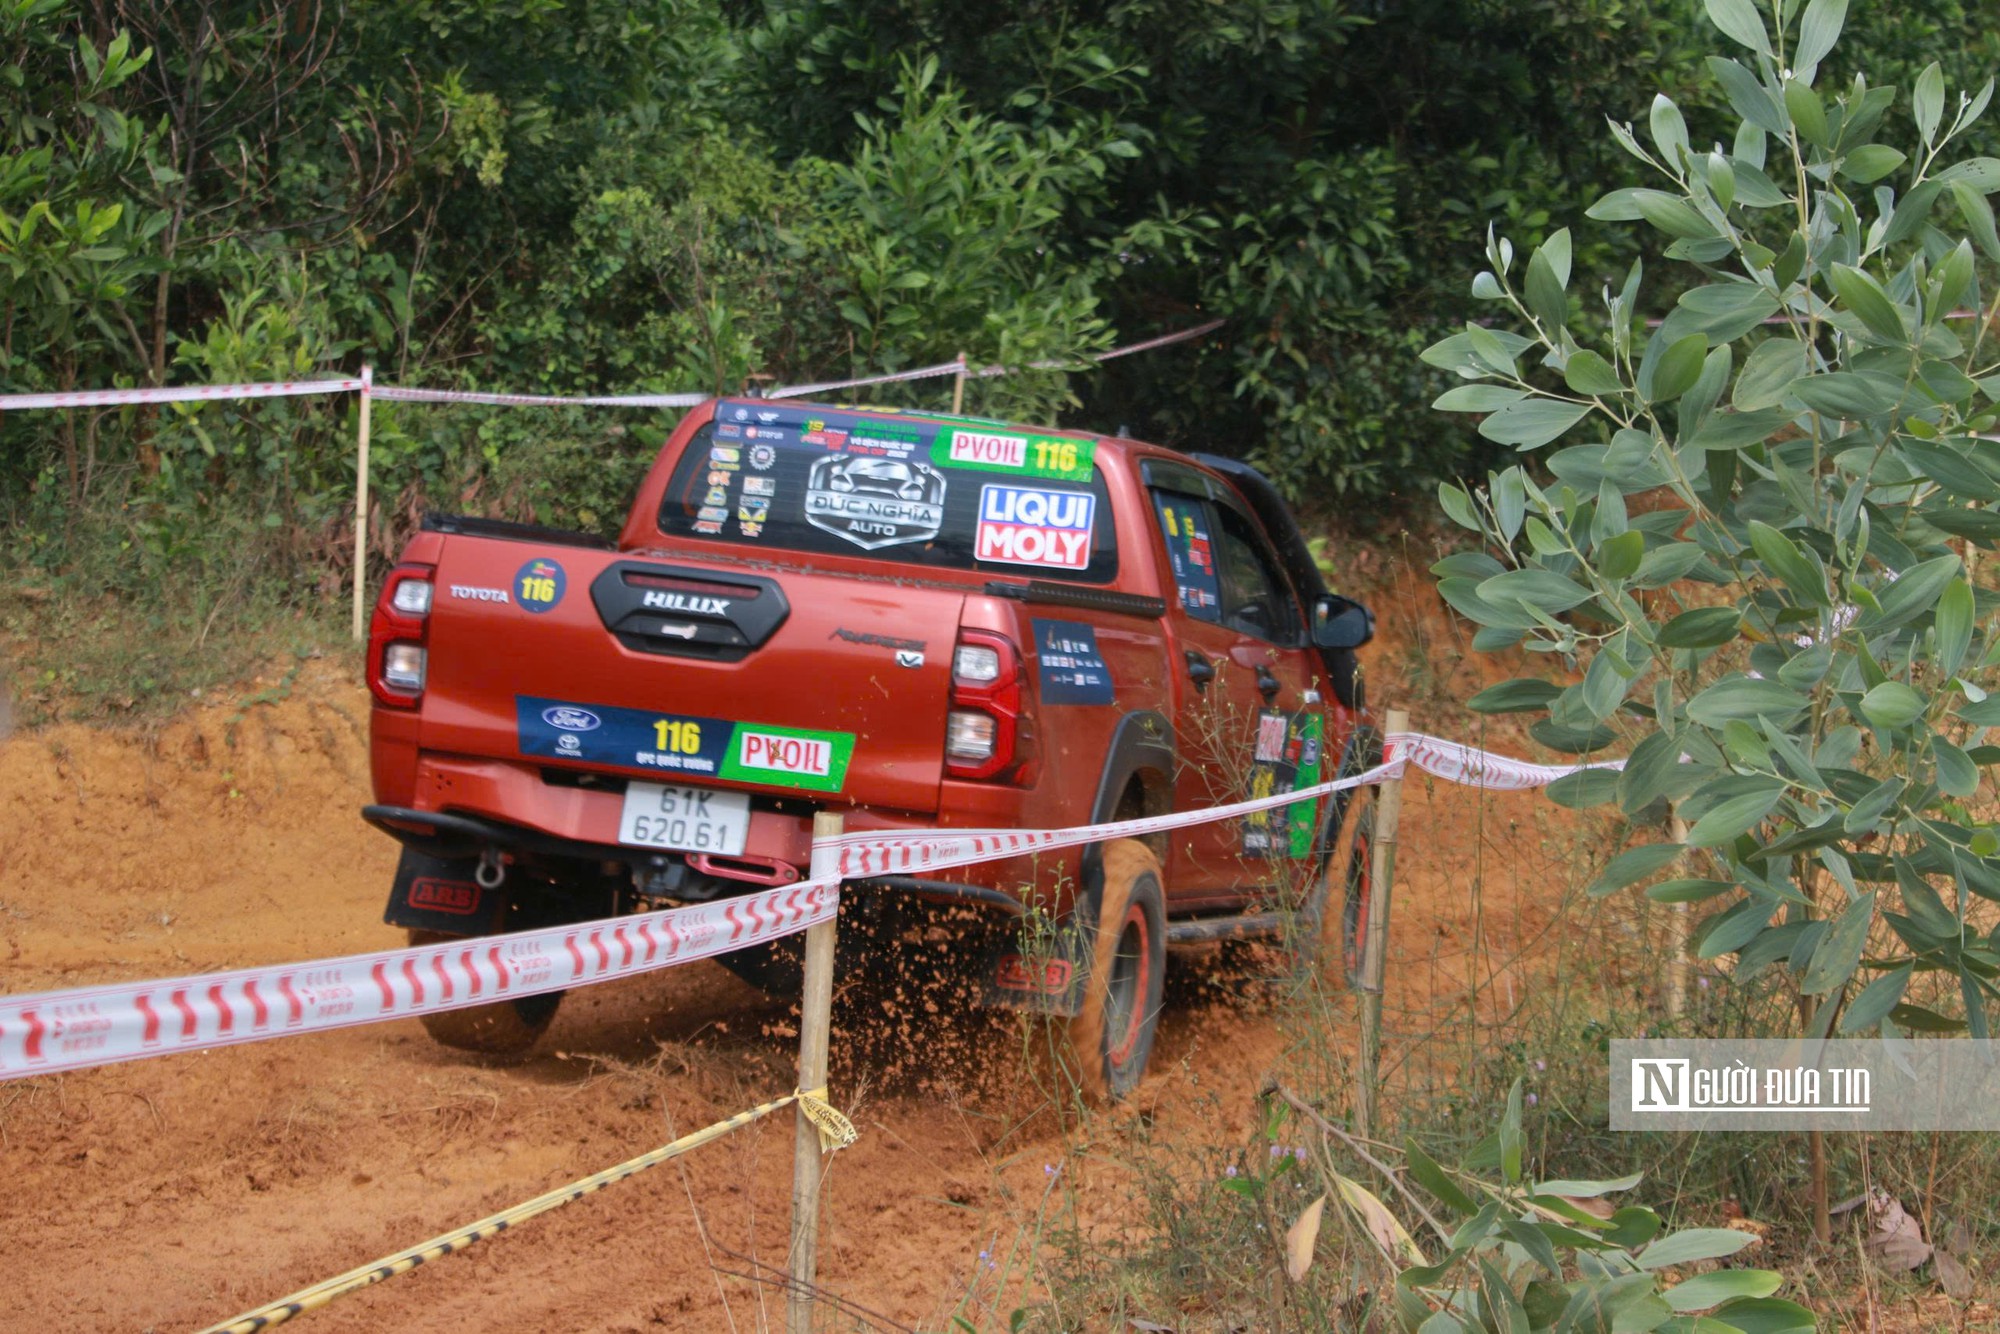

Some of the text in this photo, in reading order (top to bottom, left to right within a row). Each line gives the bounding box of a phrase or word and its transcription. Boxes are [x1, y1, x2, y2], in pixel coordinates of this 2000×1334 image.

[955, 434, 1020, 465] PVOIL
[1035, 440, 1078, 472] 116
[985, 488, 1089, 529] LIQUI
[848, 520, 897, 537] AUTO
[981, 524, 1088, 564] MOLY
[450, 584, 510, 604] TOYOTA
[521, 576, 557, 603] 116
[643, 590, 731, 616] HILUX
[551, 709, 590, 729] Ford
[653, 719, 702, 756] 116
[744, 735, 824, 774] PVOIL
[660, 787, 714, 818] 61K
[632, 815, 729, 851] 620.61
